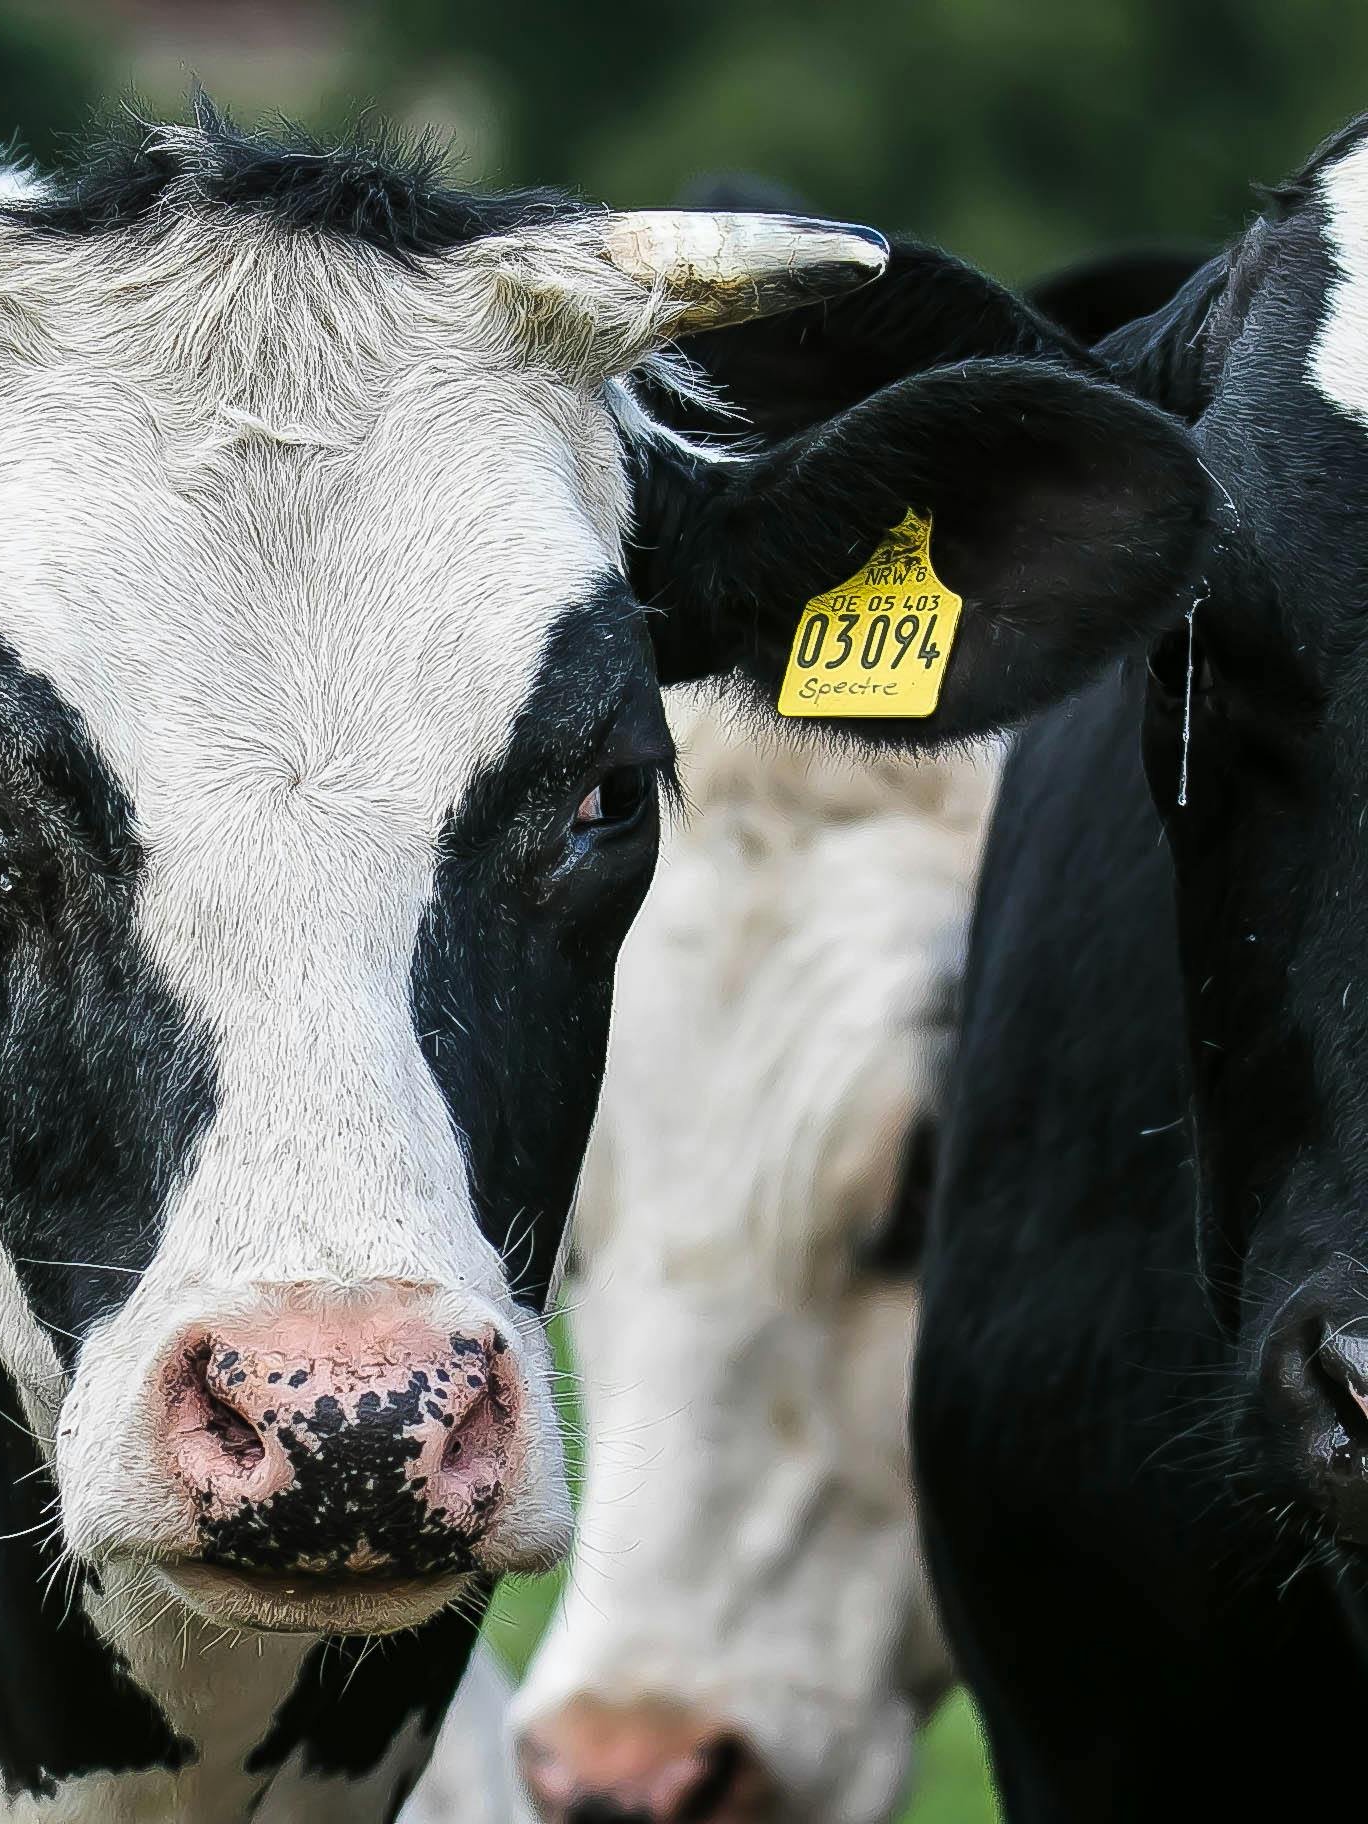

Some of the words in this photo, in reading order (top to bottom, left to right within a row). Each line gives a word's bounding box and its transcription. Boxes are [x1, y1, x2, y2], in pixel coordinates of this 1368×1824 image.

[832, 595, 861, 612] DE
[867, 595, 896, 612] 05
[903, 595, 941, 612] 403
[796, 613, 941, 670] 03094
[798, 677, 899, 705] Spectre
